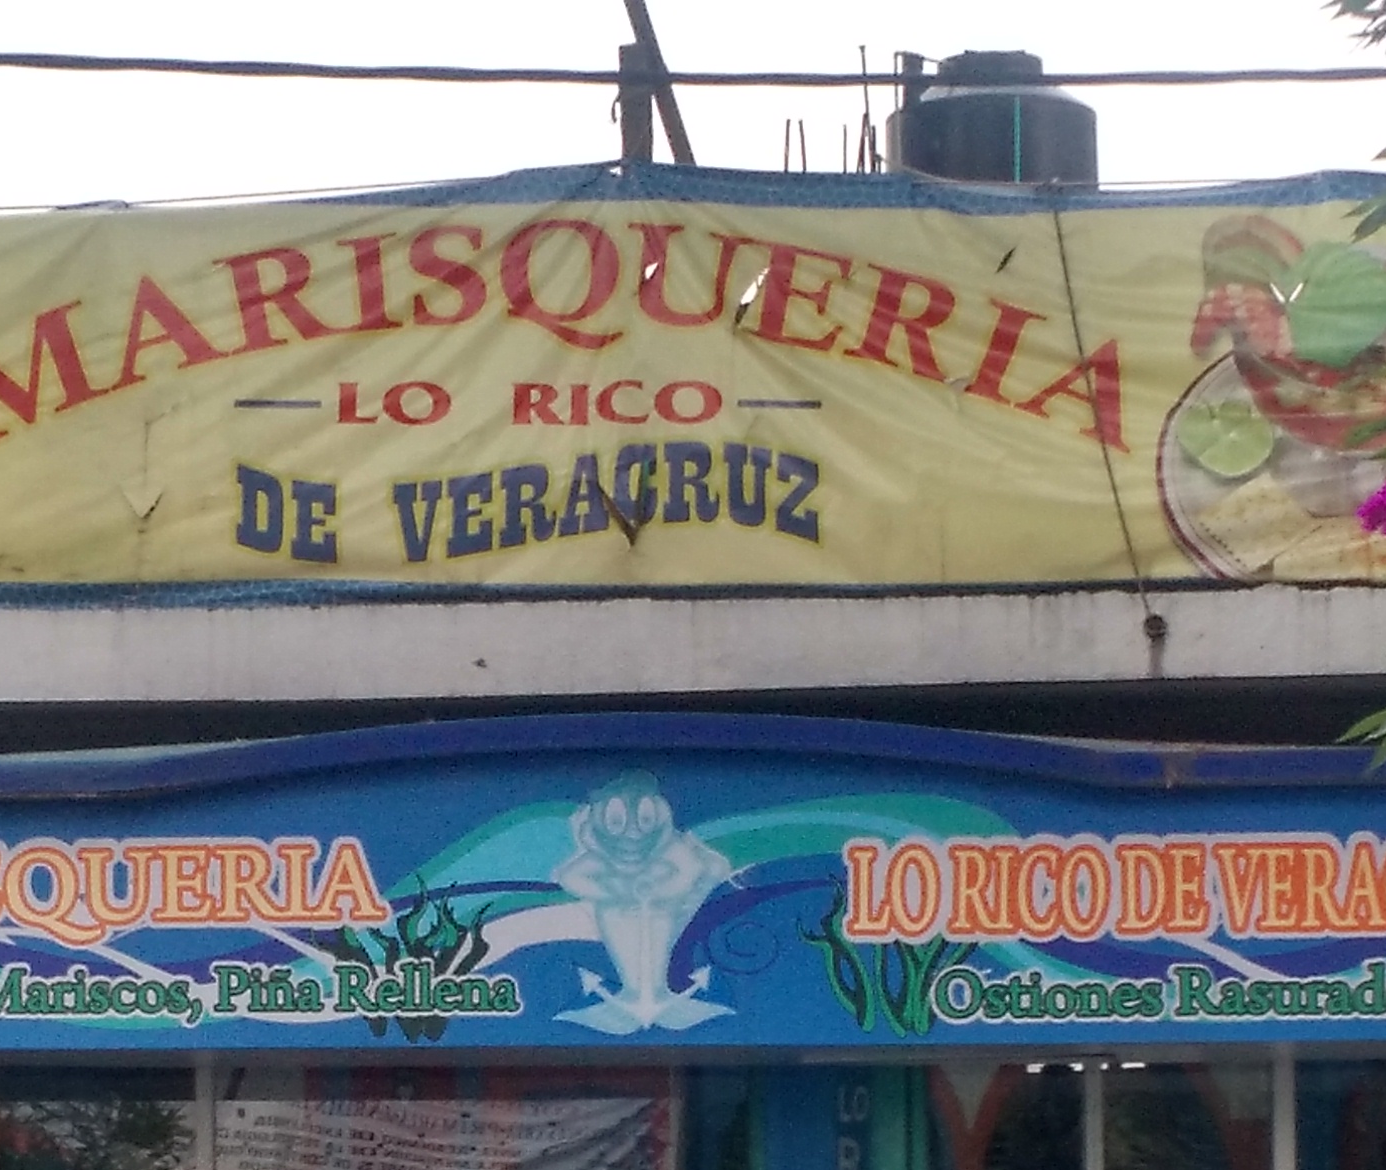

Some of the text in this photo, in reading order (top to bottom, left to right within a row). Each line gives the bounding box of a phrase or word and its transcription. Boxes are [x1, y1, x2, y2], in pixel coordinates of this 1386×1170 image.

[337, 379, 724, 428] LO RICO
[237, 441, 823, 563] DE VERACRUZ
[847, 845, 941, 934] LO
[948, 844, 1113, 933] RICO
[1116, 842, 1209, 933] DE
[213, 962, 324, 1014] Piña
[335, 960, 522, 1014] Rellena
[935, 967, 1164, 1020] Ostiones
[839, 1086, 869, 1125] LO
